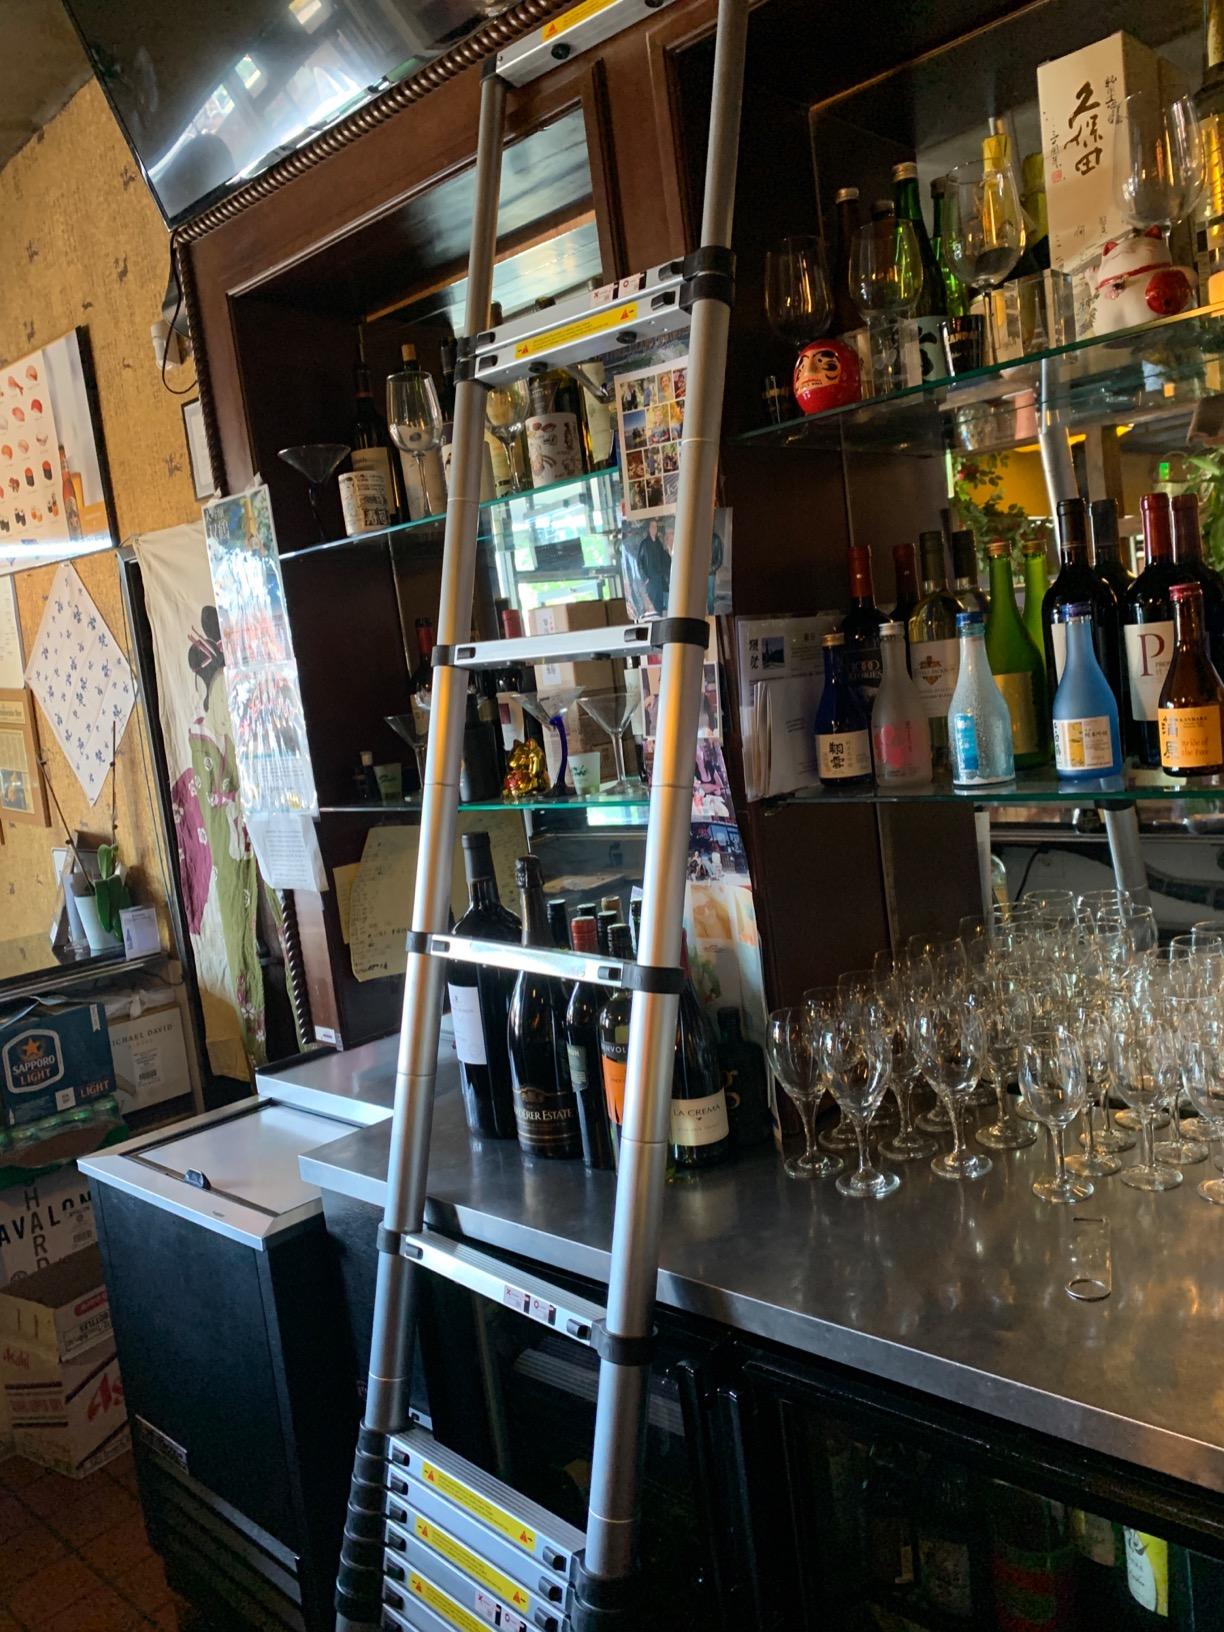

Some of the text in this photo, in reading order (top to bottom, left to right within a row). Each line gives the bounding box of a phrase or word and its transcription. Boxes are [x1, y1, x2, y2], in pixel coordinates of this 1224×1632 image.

[1063, 80, 1103, 176] 久保田
[1137, 633, 1165, 677] P
[112, 1033, 145, 1047] ICHAEL
[12, 1055, 56, 1075] SAPPORO
[20, 1067, 52, 1086] LIGHT
[80, 1079, 110, 1098] LIGHT
[542, 1107, 573, 1121] ESTATE
[687, 1103, 721, 1118] CREMA
